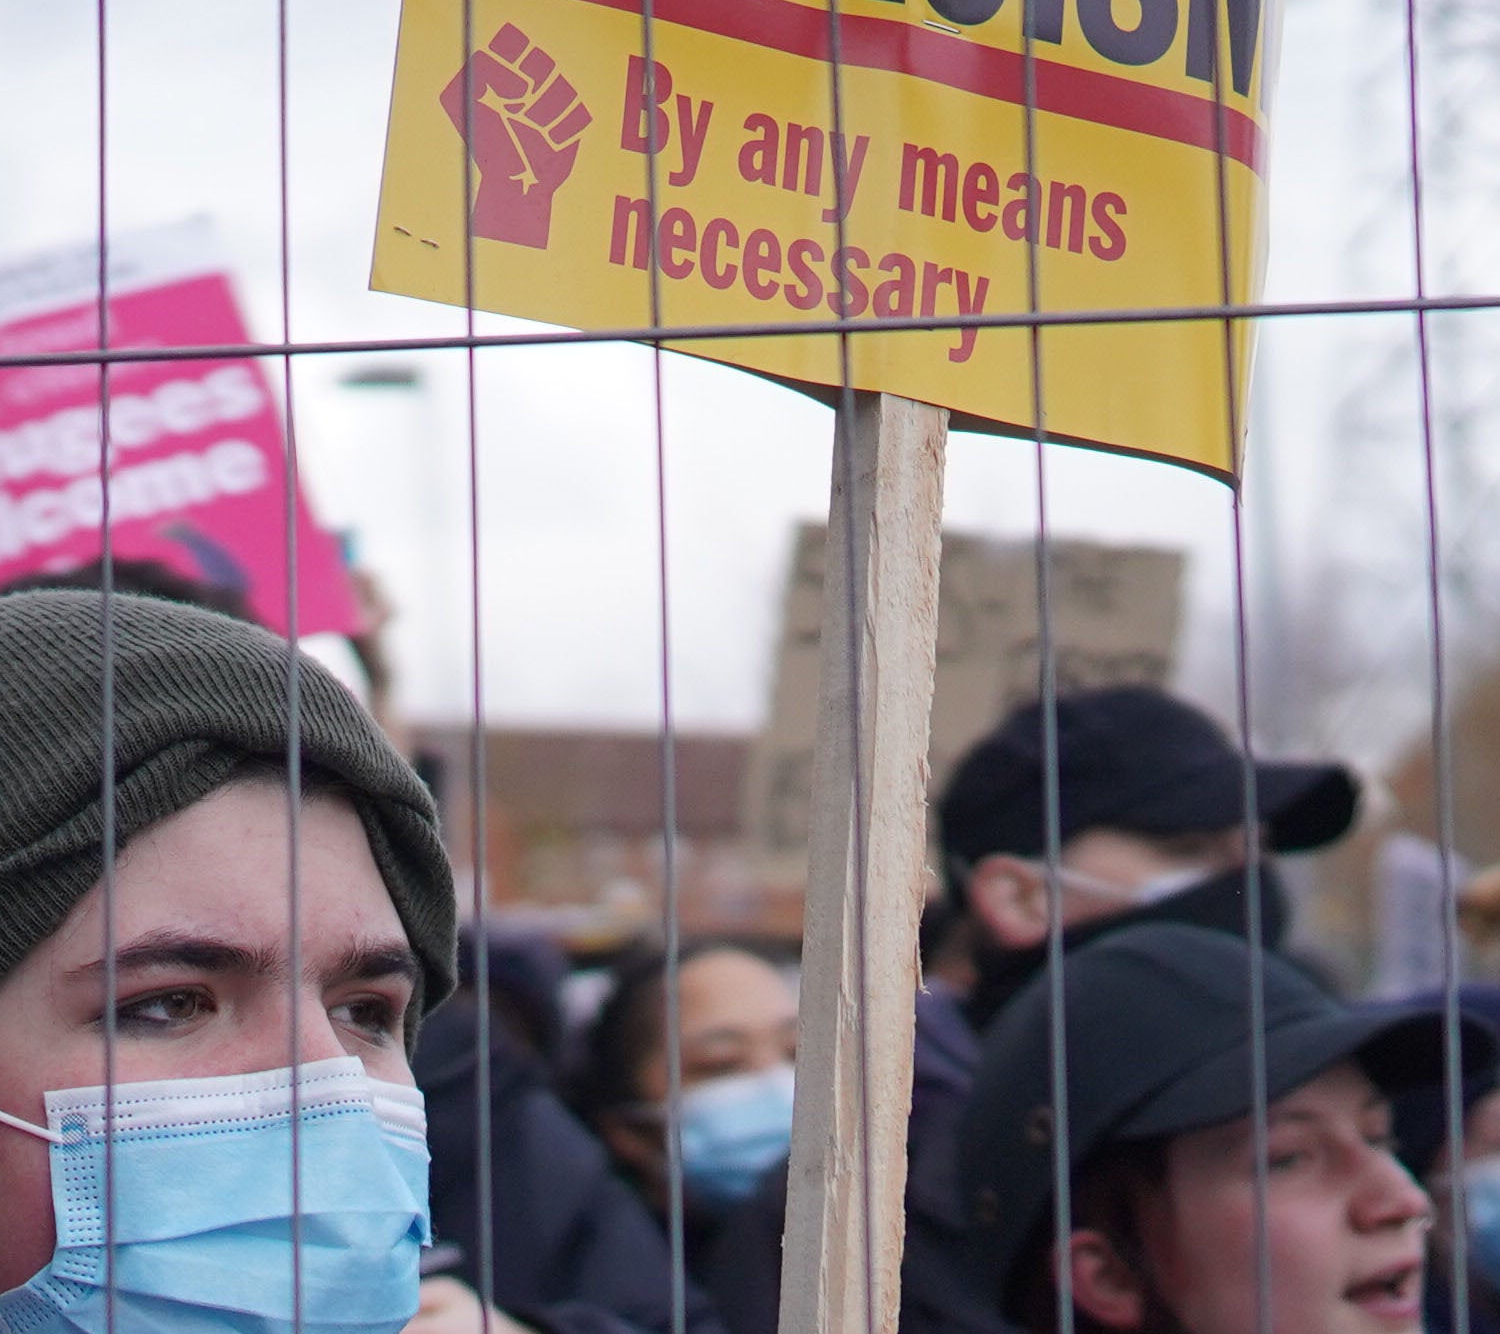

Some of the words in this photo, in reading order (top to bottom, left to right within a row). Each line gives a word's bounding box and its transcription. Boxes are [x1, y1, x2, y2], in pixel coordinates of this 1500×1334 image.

[620, 54, 715, 188] By
[738, 112, 871, 224] any
[898, 142, 1129, 263] means
[608, 193, 991, 364] necessary
